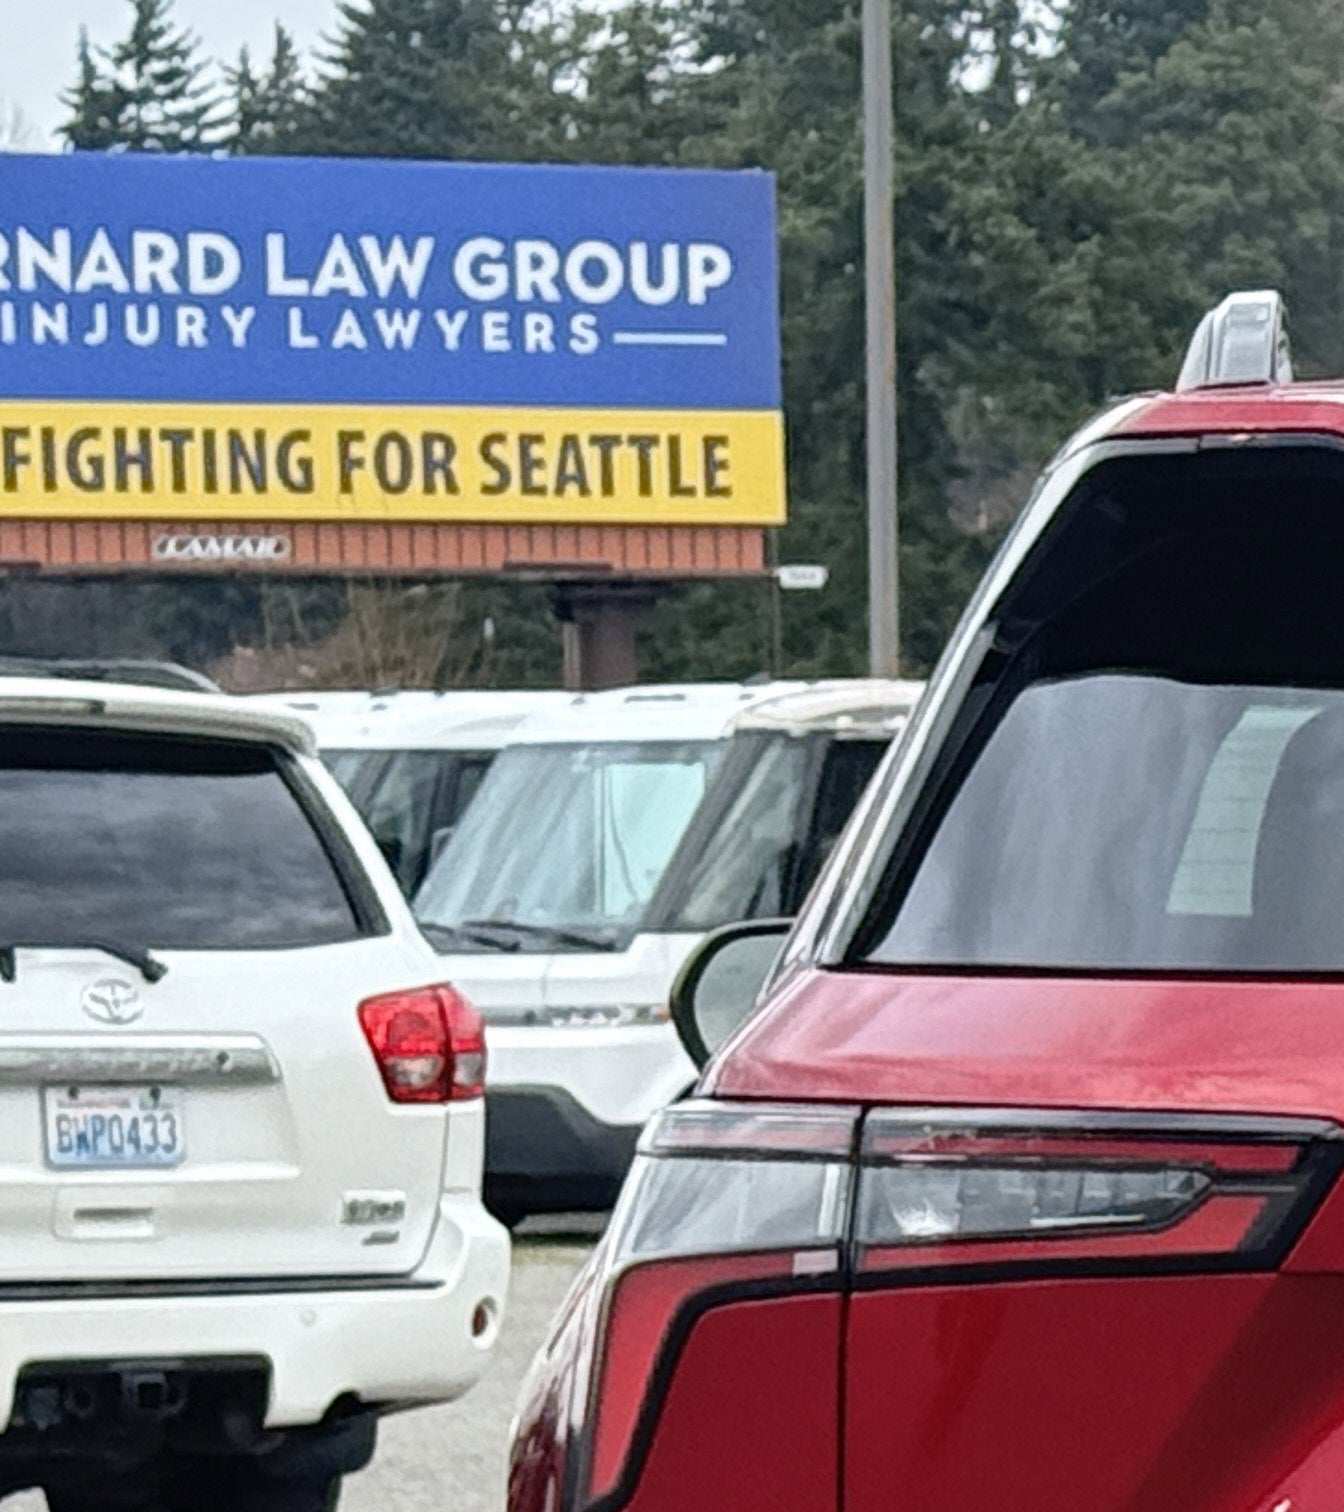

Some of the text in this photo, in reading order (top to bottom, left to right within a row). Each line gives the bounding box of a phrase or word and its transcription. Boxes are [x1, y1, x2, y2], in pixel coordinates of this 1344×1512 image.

[0, 225, 733, 305] NARD LAW GROUP
[1, 300, 600, 355] INJURY LAWYERS
[3, 426, 733, 497] FIGHTING FOR SEATTLE
